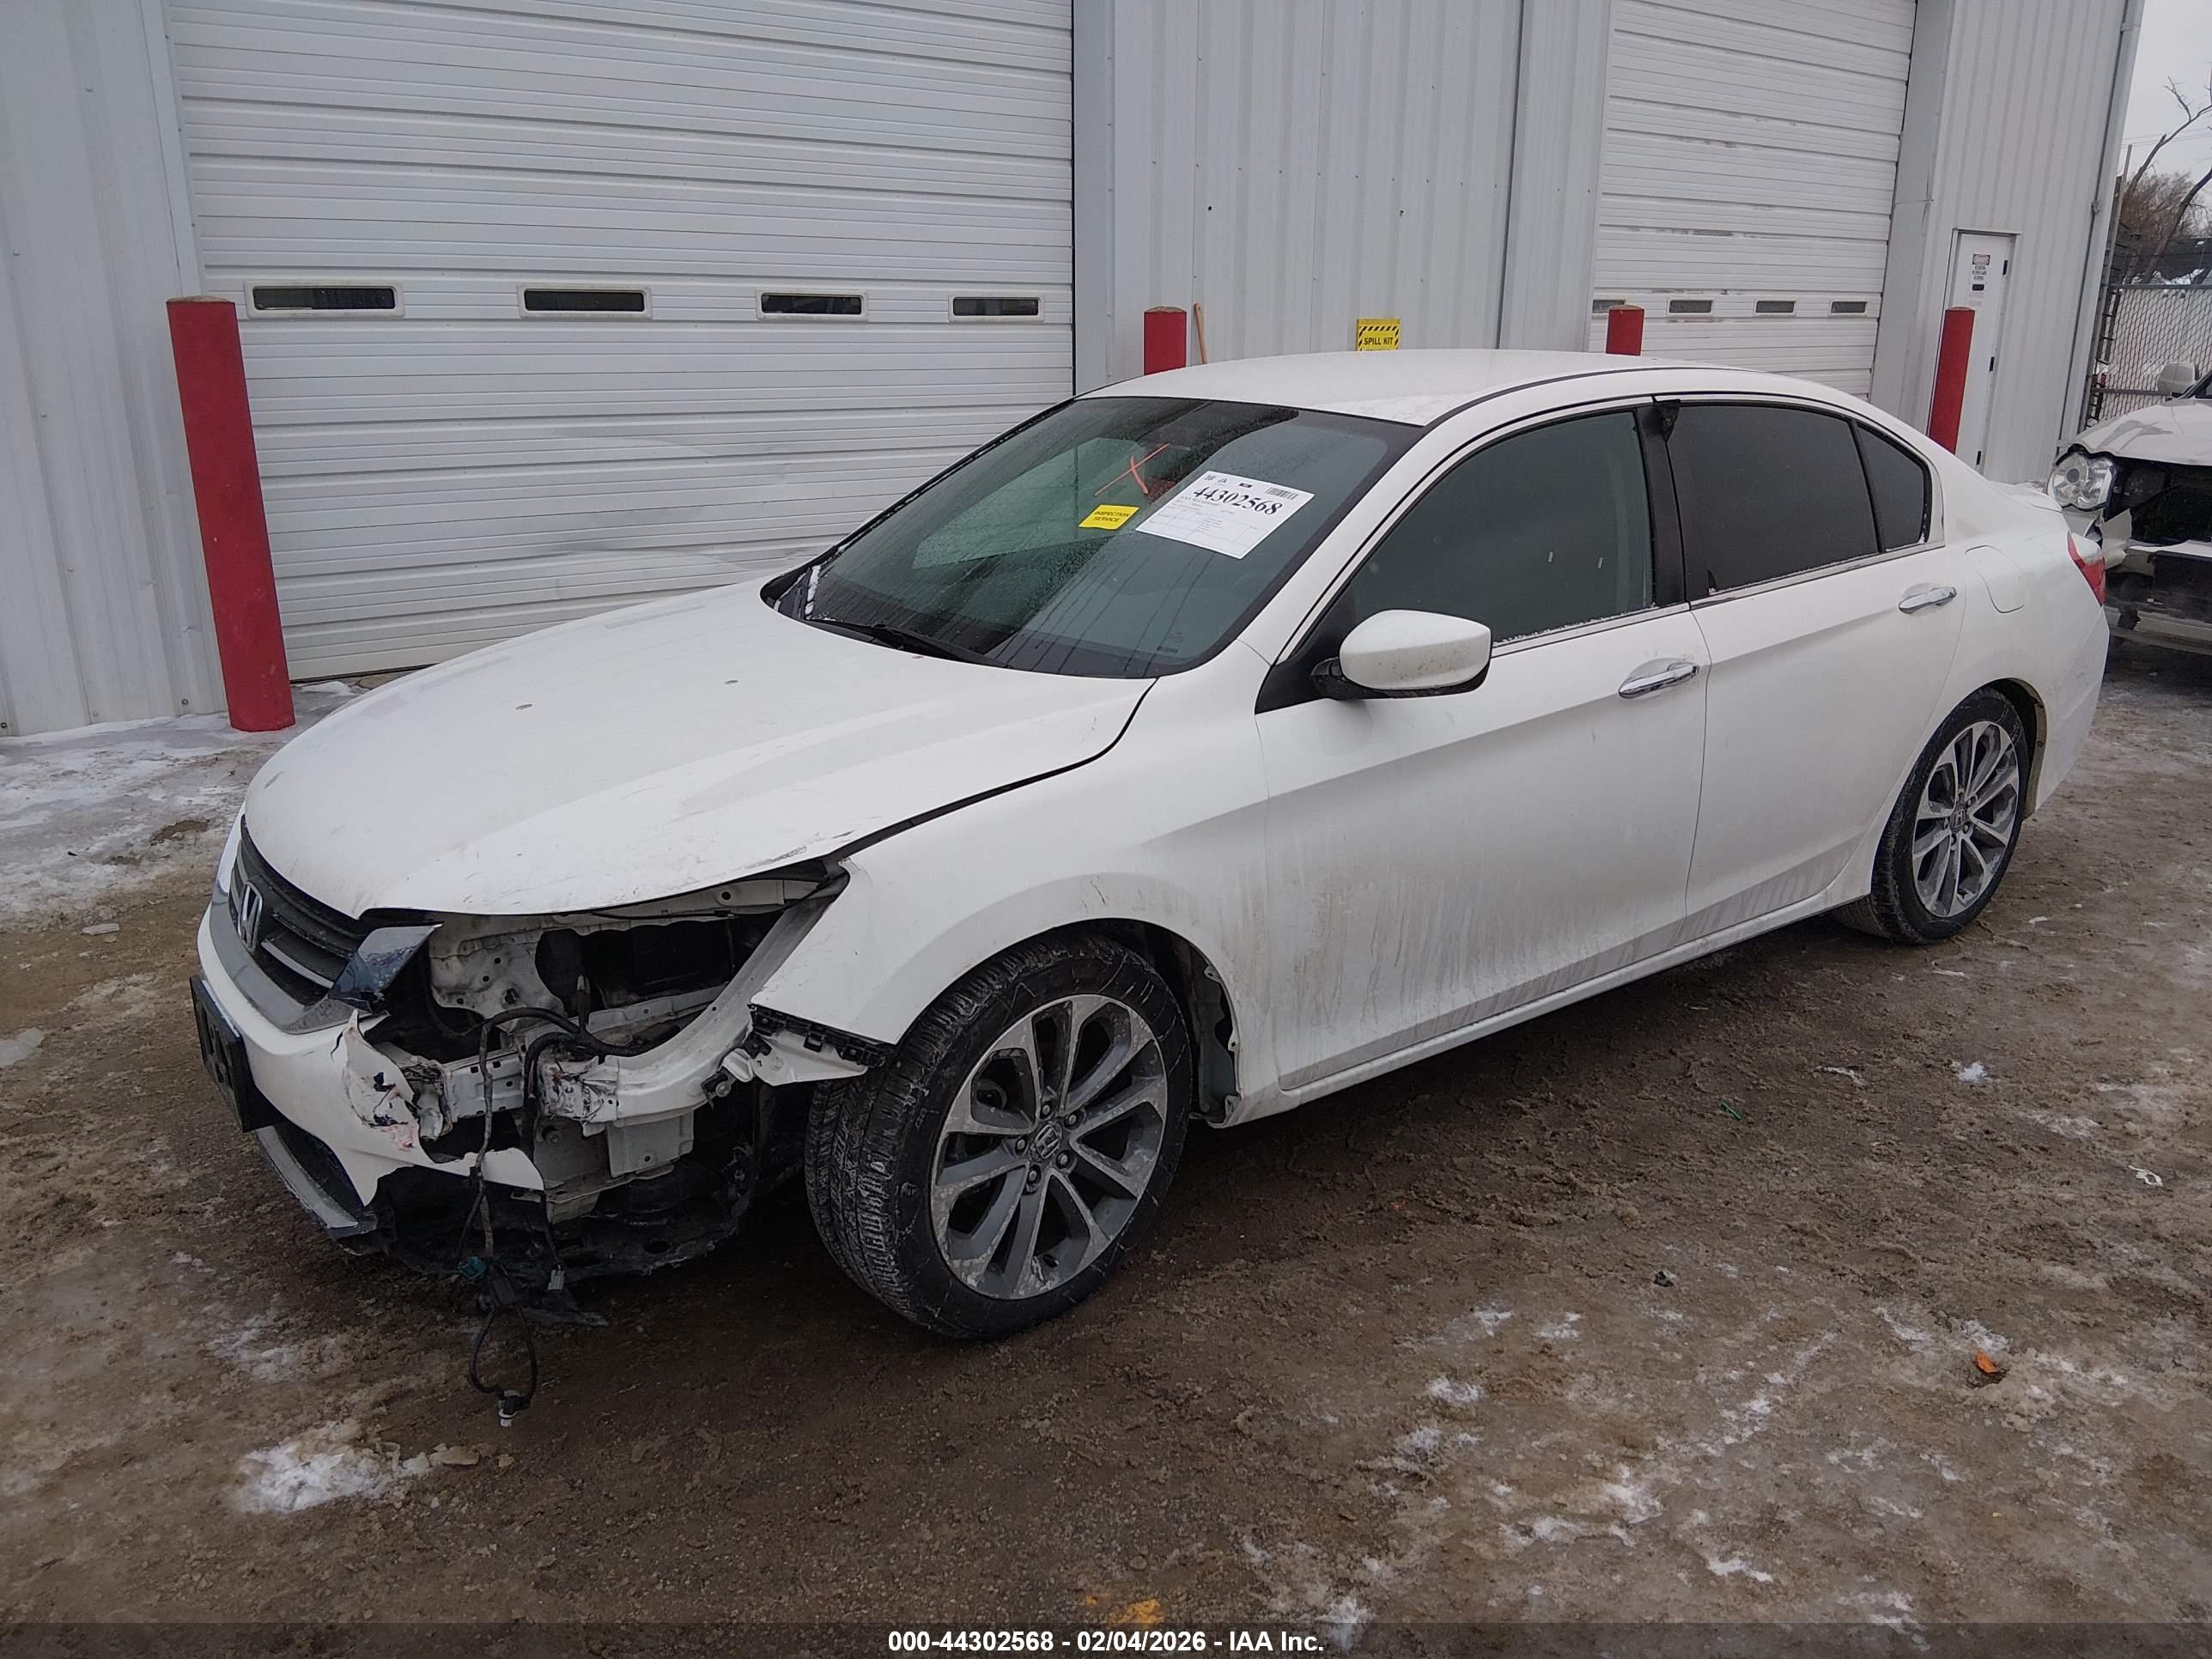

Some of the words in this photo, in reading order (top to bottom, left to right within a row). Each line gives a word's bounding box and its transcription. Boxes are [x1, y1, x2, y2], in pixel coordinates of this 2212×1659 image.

[1364, 337, 1382, 345] SPILL
[1383, 337, 1394, 345] KIT
[1194, 486, 1283, 515] 44302568
